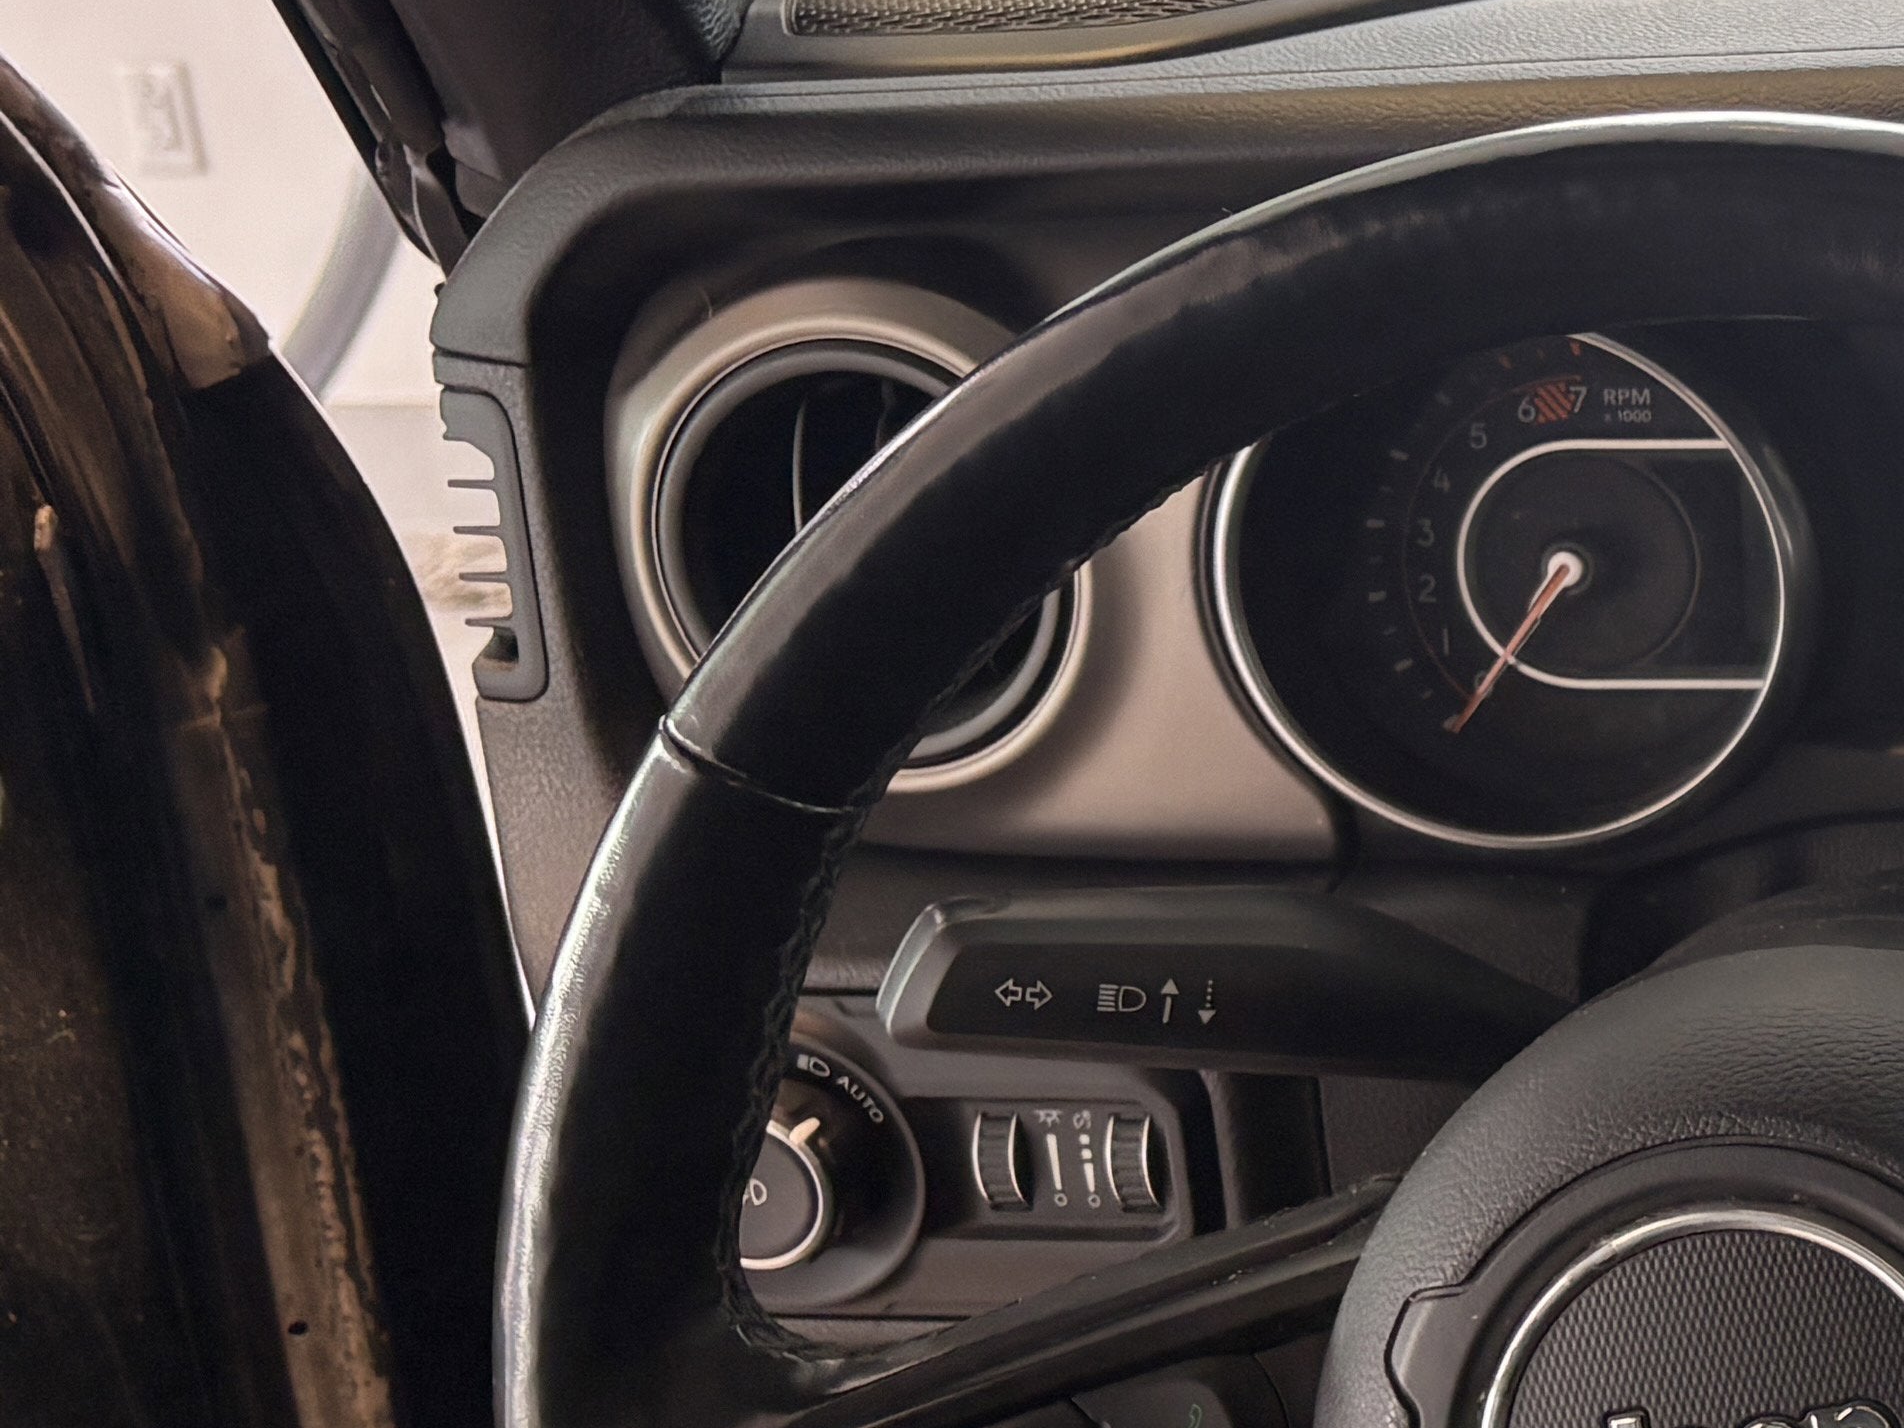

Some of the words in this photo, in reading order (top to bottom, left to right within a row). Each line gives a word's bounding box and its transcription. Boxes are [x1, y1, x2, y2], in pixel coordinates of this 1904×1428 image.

[1517, 396, 1536, 423] 6
[1569, 386, 1587, 413] 7
[1603, 388, 1651, 406] RPM
[1617, 409, 1652, 423] 1000
[1469, 423, 1487, 449] 5
[1432, 469, 1451, 493] 4
[1417, 519, 1435, 548] 3
[1418, 575, 1436, 603] 2
[835, 1074, 884, 1126] AUTO
